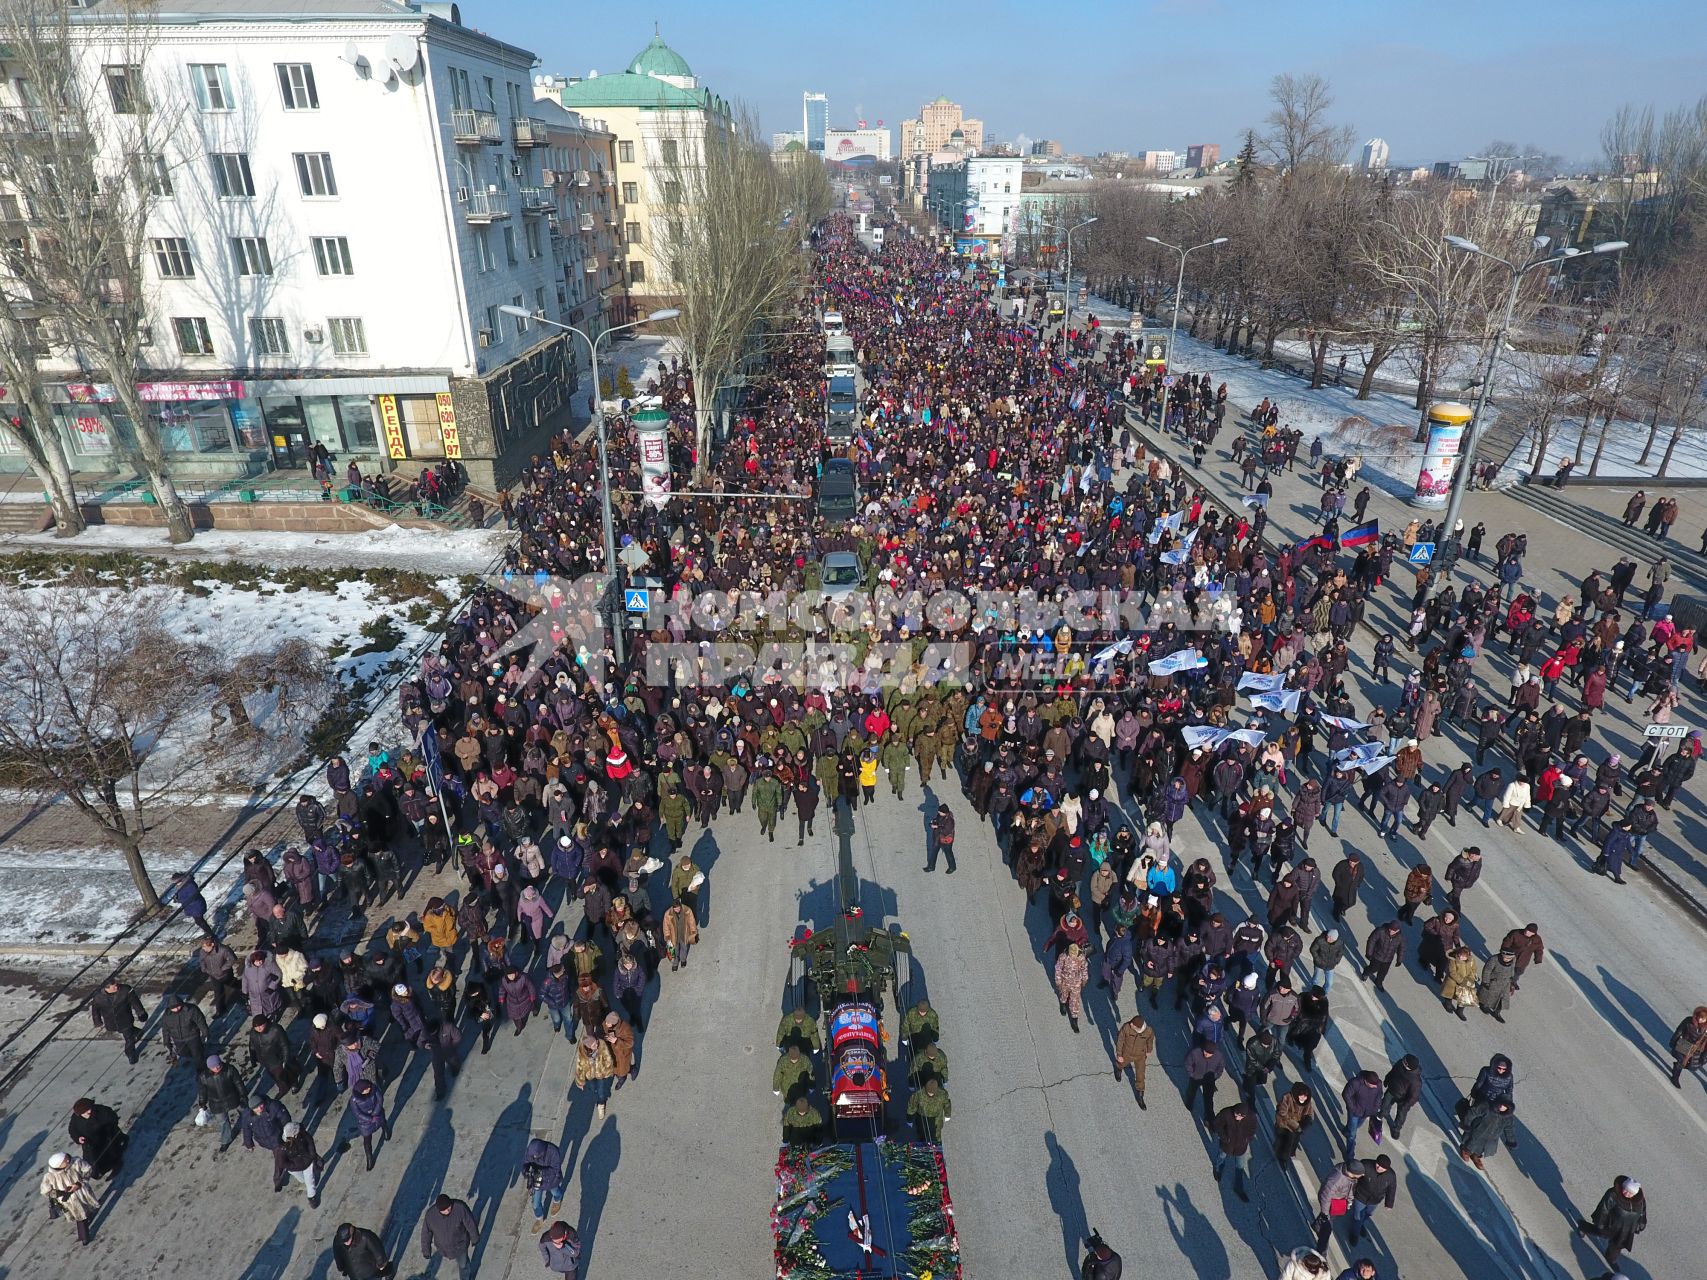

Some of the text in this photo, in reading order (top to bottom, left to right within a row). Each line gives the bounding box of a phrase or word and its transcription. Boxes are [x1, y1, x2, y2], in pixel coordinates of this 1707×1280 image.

[438, 395, 452, 406] 050
[441, 411, 454, 423] 620
[383, 394, 403, 457] АРЕНДА
[444, 429, 456, 439] 97
[447, 445, 459, 456] 97
[1649, 726, 1685, 736] СТОП
